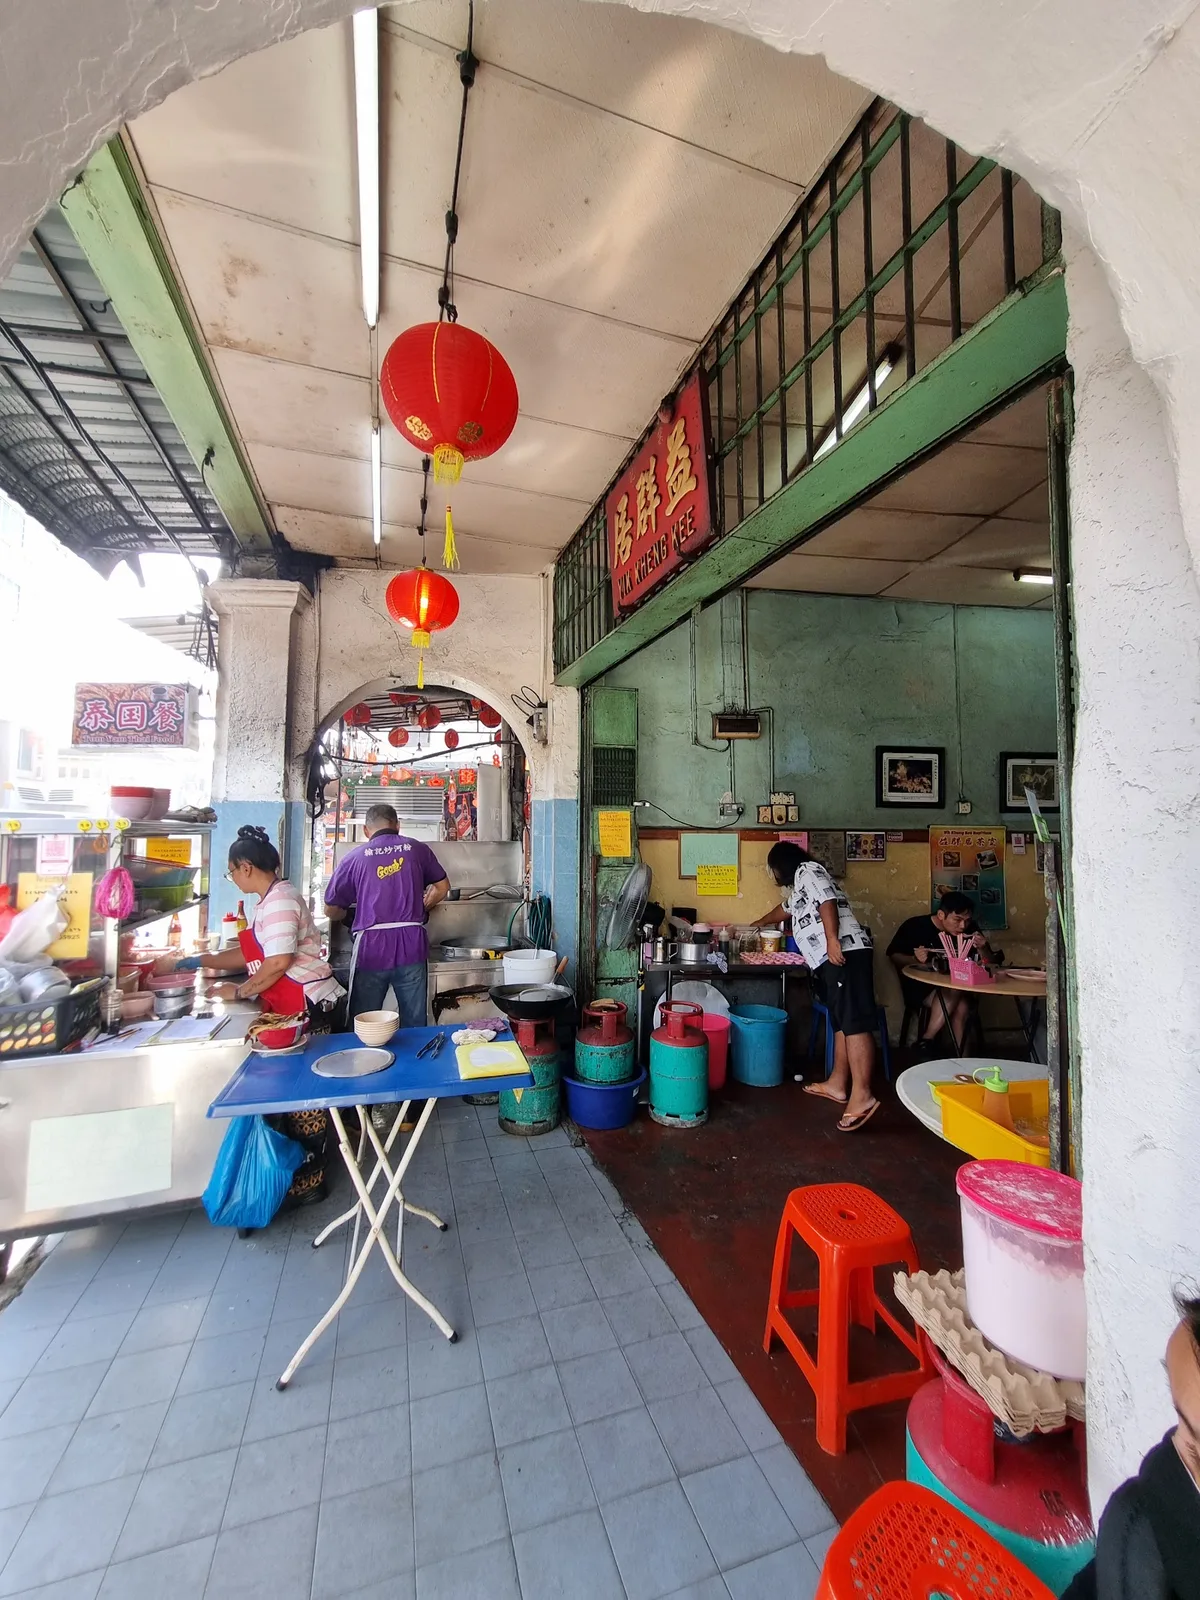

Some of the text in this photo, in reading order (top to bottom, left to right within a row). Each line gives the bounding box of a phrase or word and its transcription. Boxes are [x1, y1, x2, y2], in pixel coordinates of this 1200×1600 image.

[617, 504, 697, 599] YIK KHENG KEE
[79, 700, 184, 731] 泰国餐
[127, 734, 150, 743] Thai
[152, 734, 175, 743] Food
